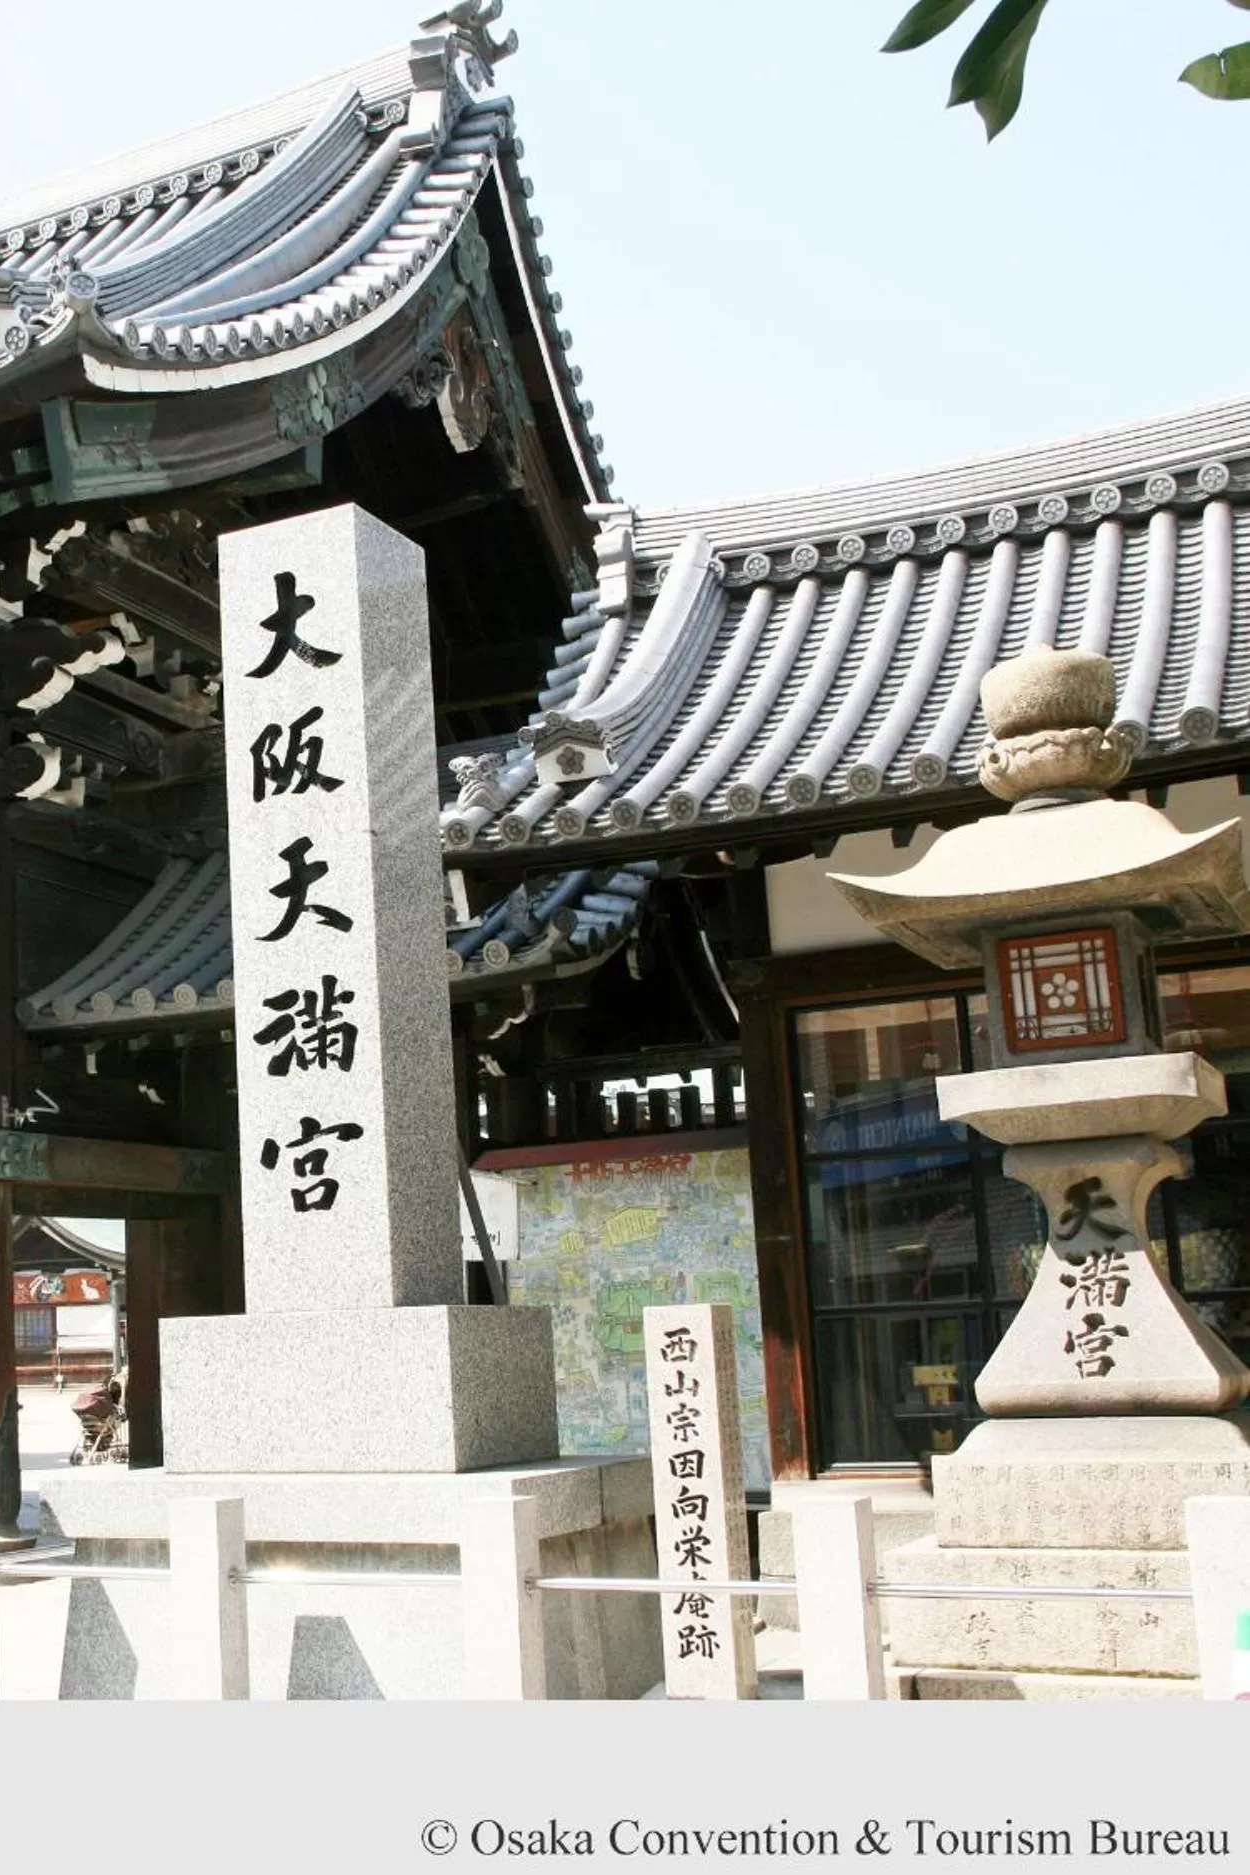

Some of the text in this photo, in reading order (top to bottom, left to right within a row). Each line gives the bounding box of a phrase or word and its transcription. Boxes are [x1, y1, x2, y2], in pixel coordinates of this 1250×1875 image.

[244, 571, 364, 1213] 大阪天満宮
